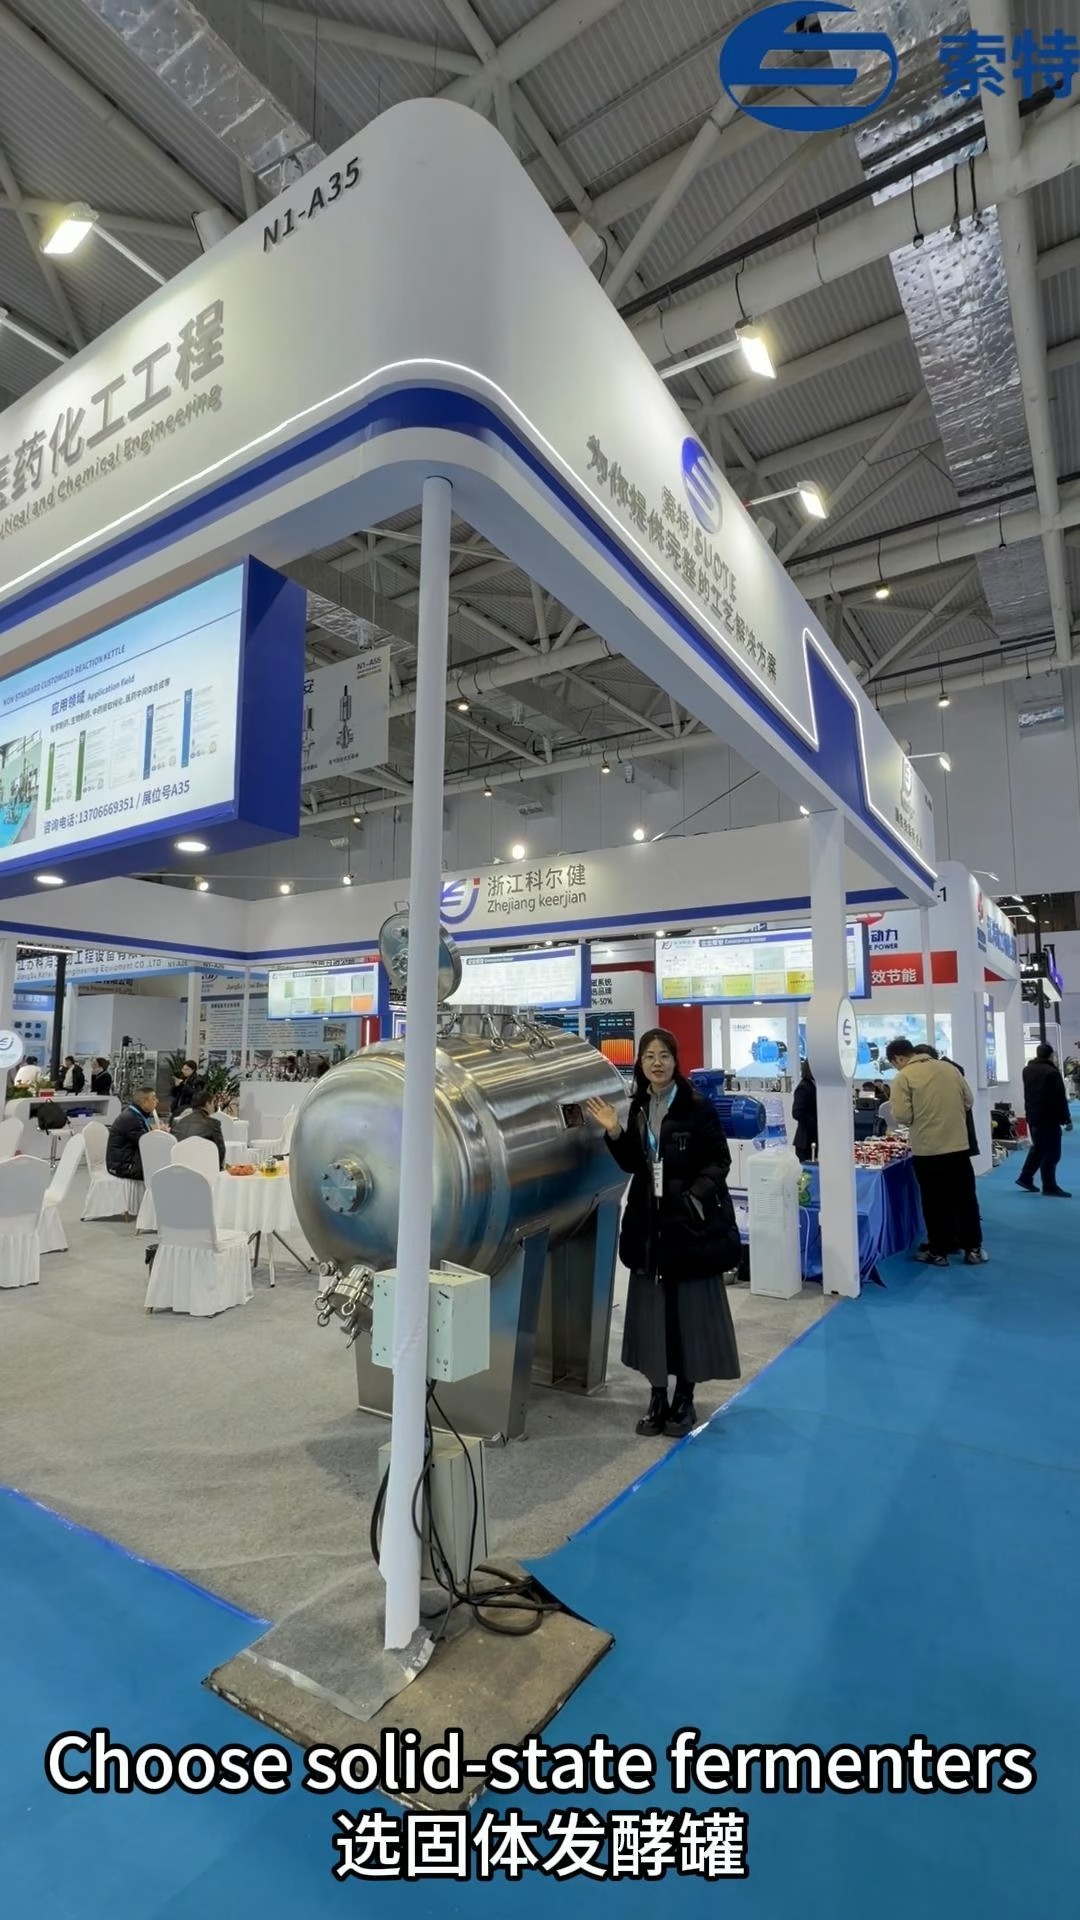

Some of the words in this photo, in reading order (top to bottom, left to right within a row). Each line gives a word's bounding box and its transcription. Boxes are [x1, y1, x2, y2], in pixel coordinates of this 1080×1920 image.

[262, 157, 361, 252] N1-A35
[32, 486, 57, 519] and
[57, 443, 120, 498] Chemical
[124, 384, 222, 458] Engineering
[693, 527, 737, 602] SUOTE
[103, 644, 126, 662] KETTLE
[88, 682, 120, 701] Application
[141, 779, 190, 807] 展位号A35
[487, 864, 586, 896] 浙江科尔健
[487, 897, 536, 914] Zhejiang
[539, 891, 587, 908] keerjian
[871, 928, 898, 942] 动力
[871, 967, 917, 984] 效节能
